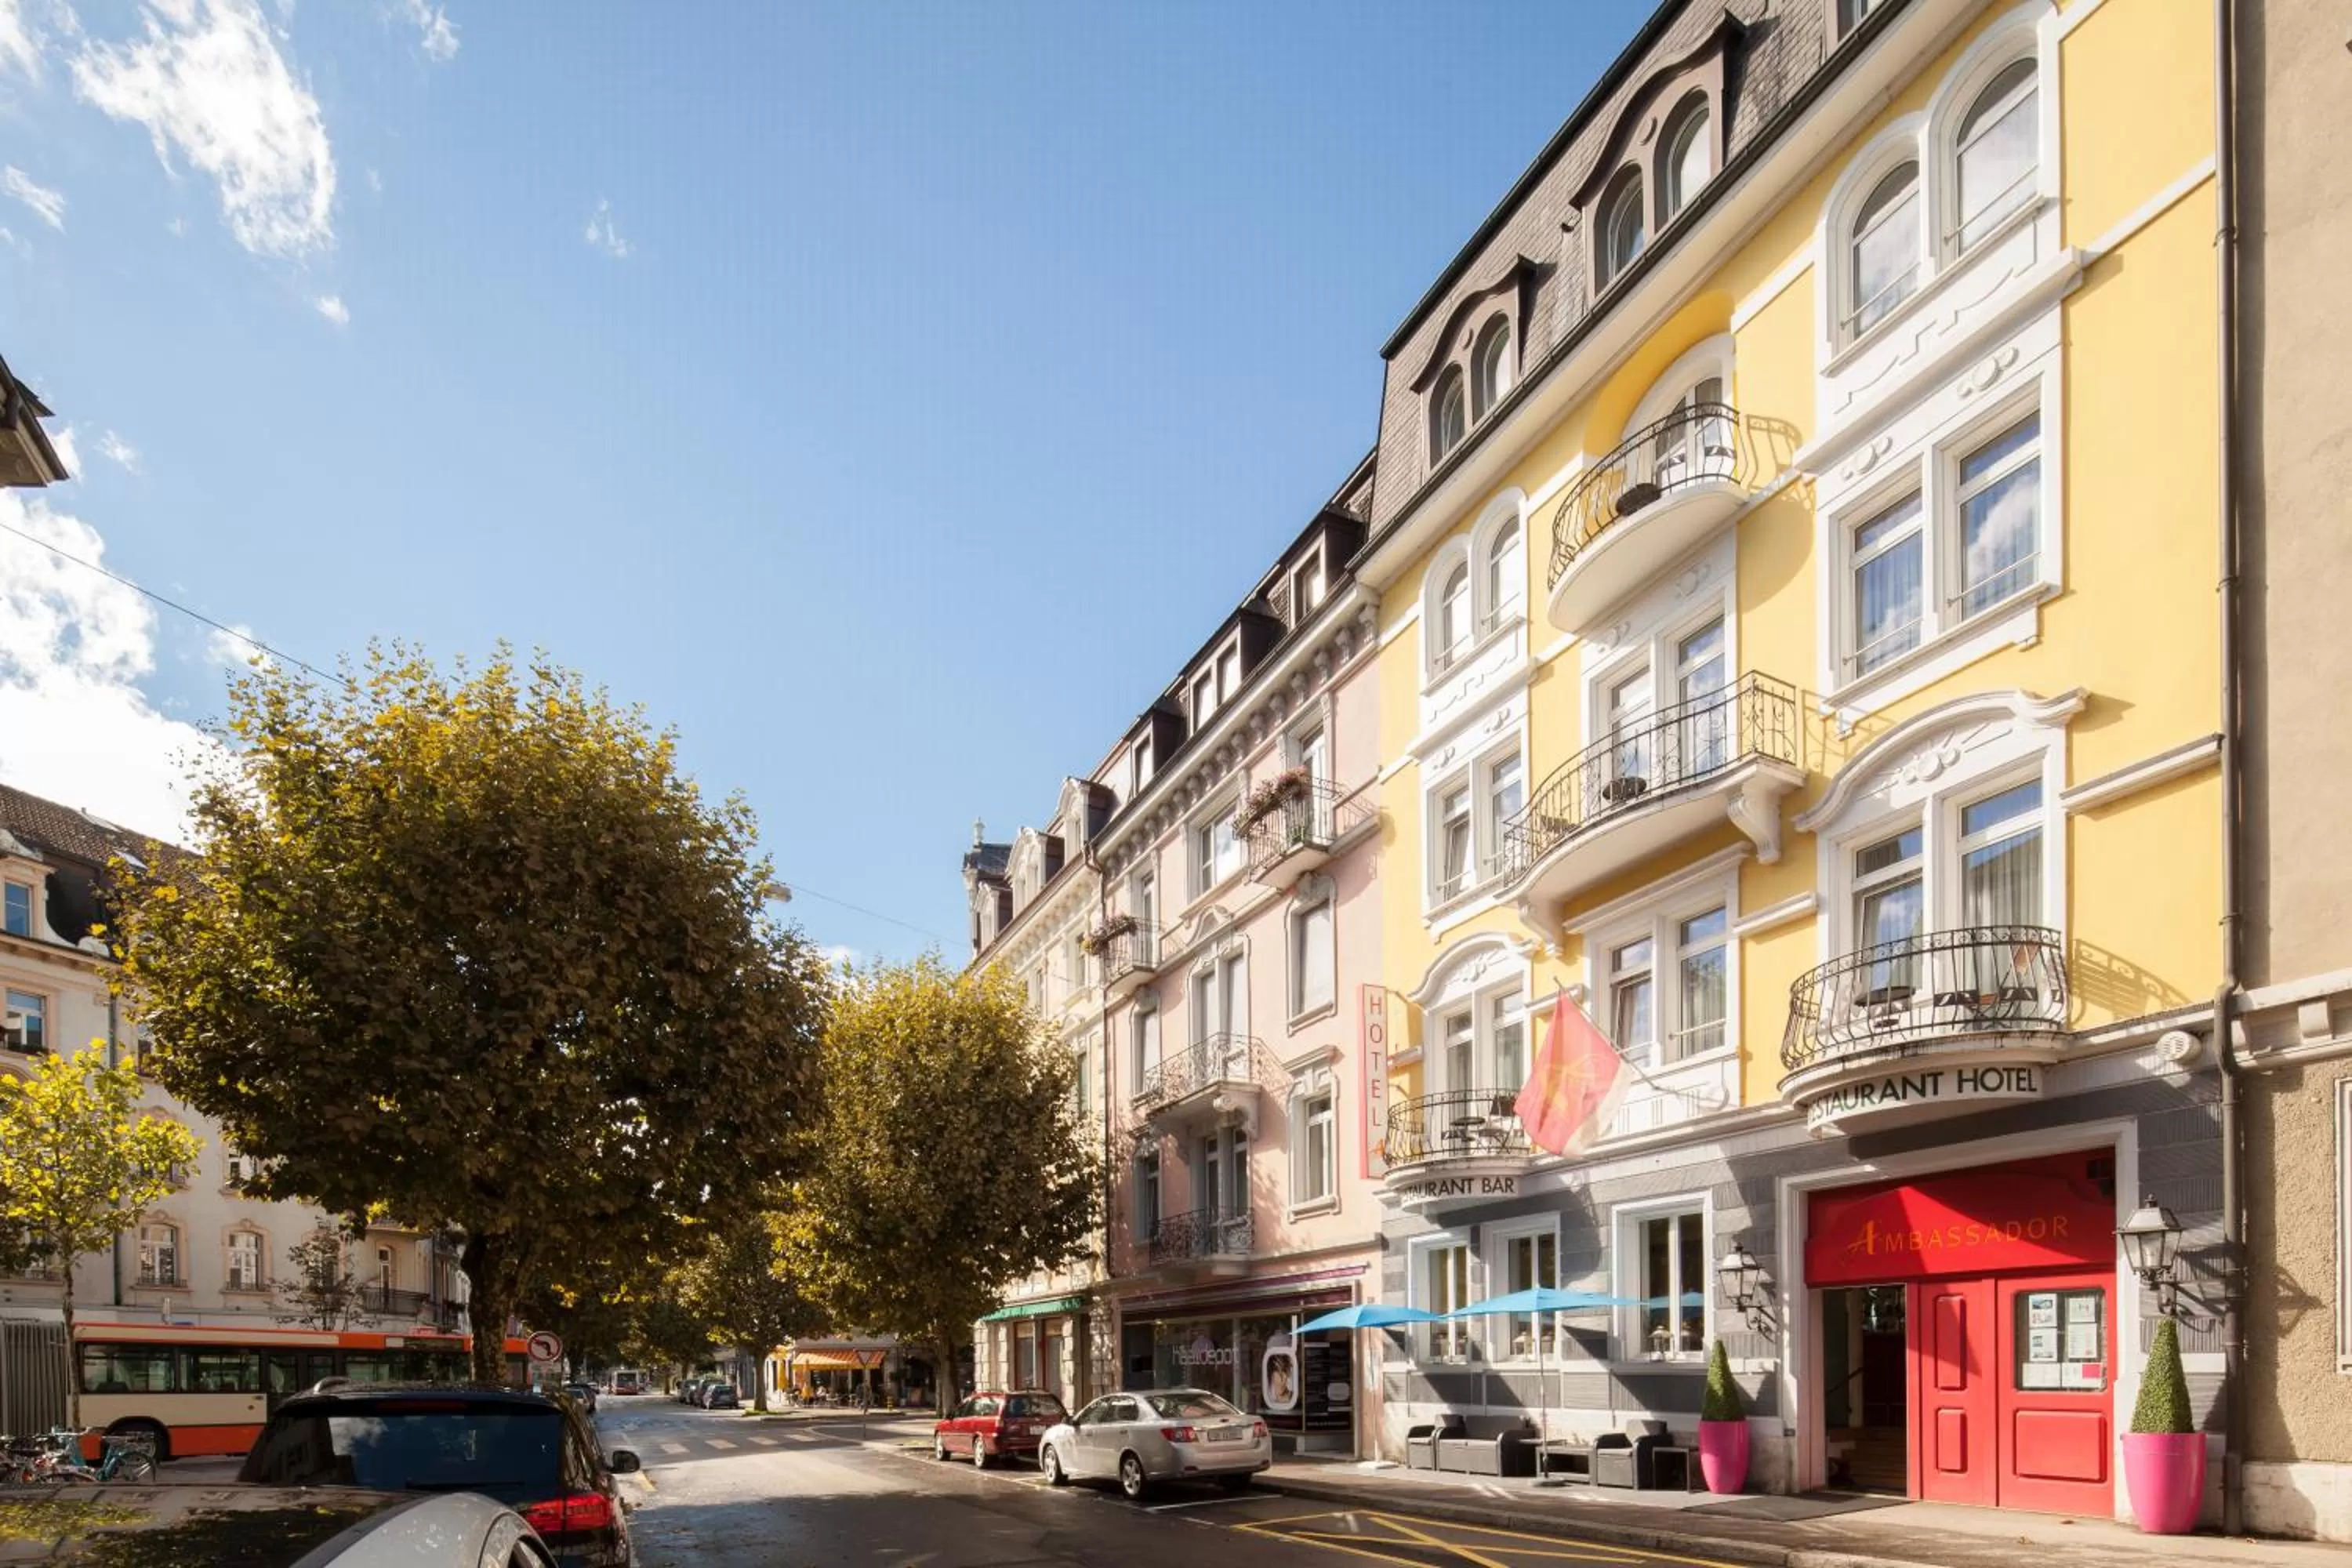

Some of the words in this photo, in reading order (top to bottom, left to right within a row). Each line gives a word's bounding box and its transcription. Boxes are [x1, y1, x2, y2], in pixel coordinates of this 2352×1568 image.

[1369, 994, 1383, 1127] HOTEL
[1957, 1066, 2038, 1094] HOTEL
[1481, 1176, 1515, 1194] BAR
[1846, 1215, 2068, 1255] AMBASSADOR
